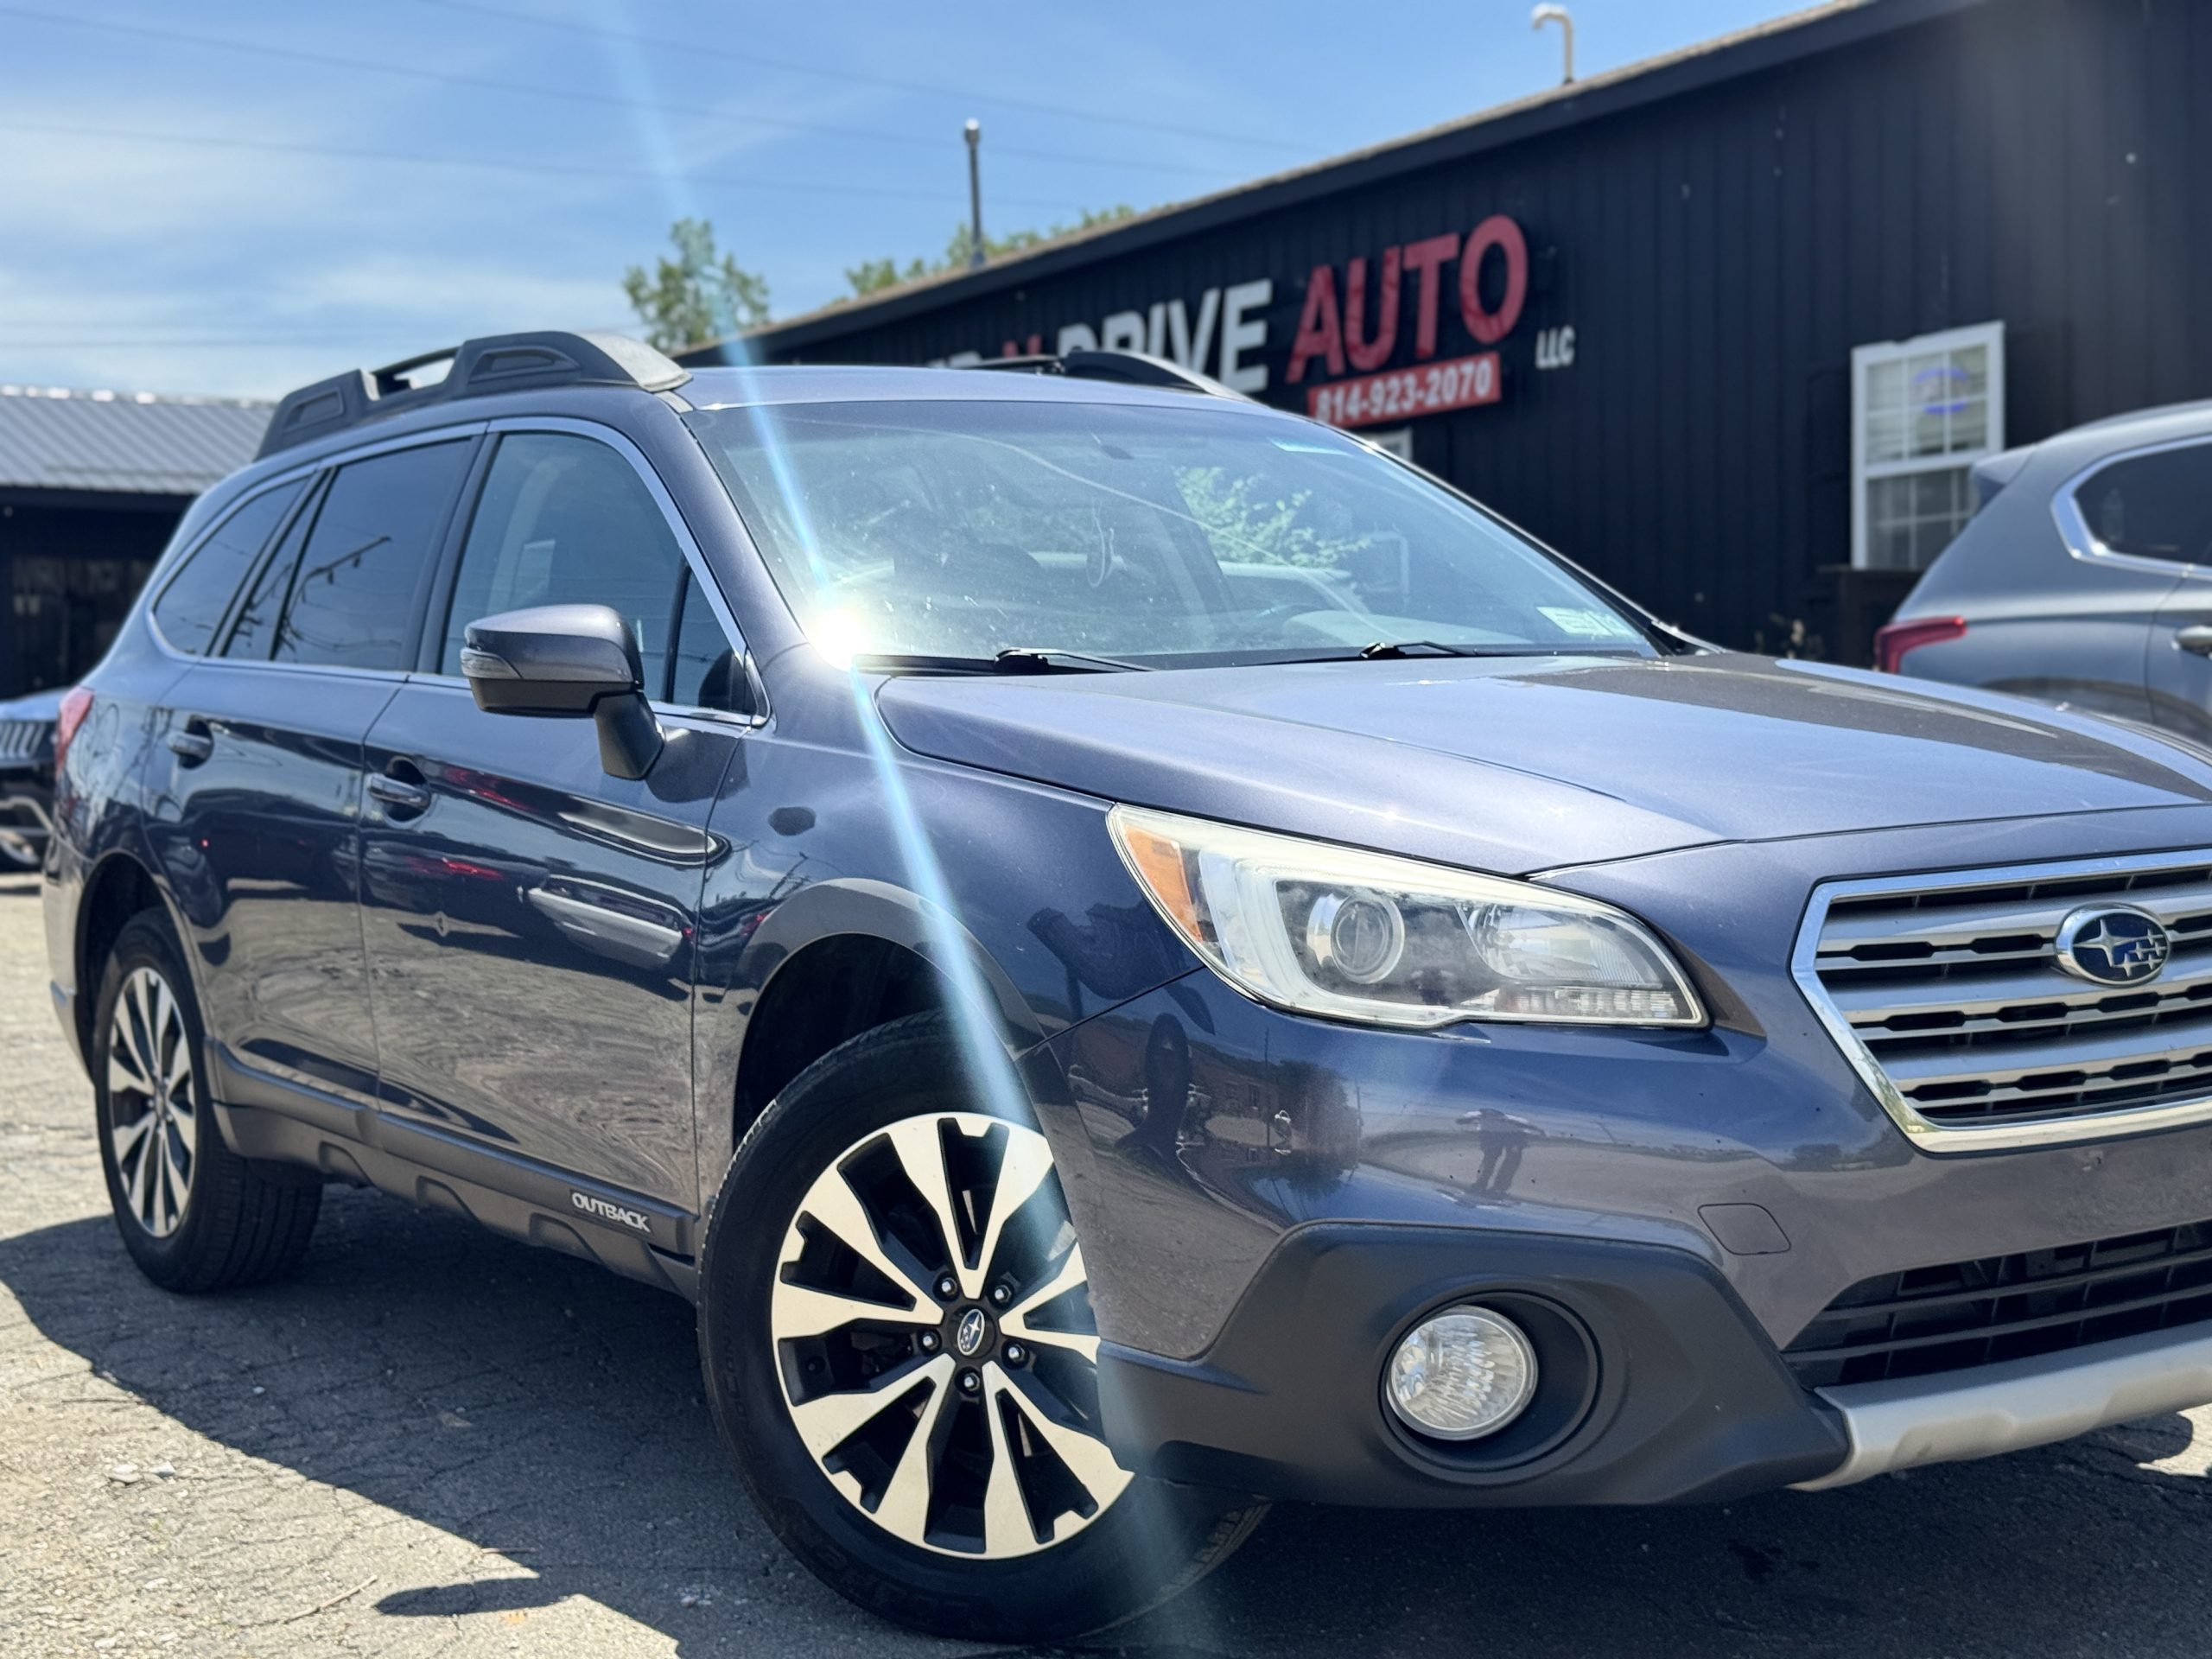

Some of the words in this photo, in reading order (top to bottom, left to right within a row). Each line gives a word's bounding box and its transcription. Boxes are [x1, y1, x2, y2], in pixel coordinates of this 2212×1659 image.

[1285, 213, 1529, 384] AUTO
[1535, 325, 1575, 369] LLC
[1314, 358, 1493, 423] 814-923-2070
[572, 1192, 651, 1232] OUTBACK
